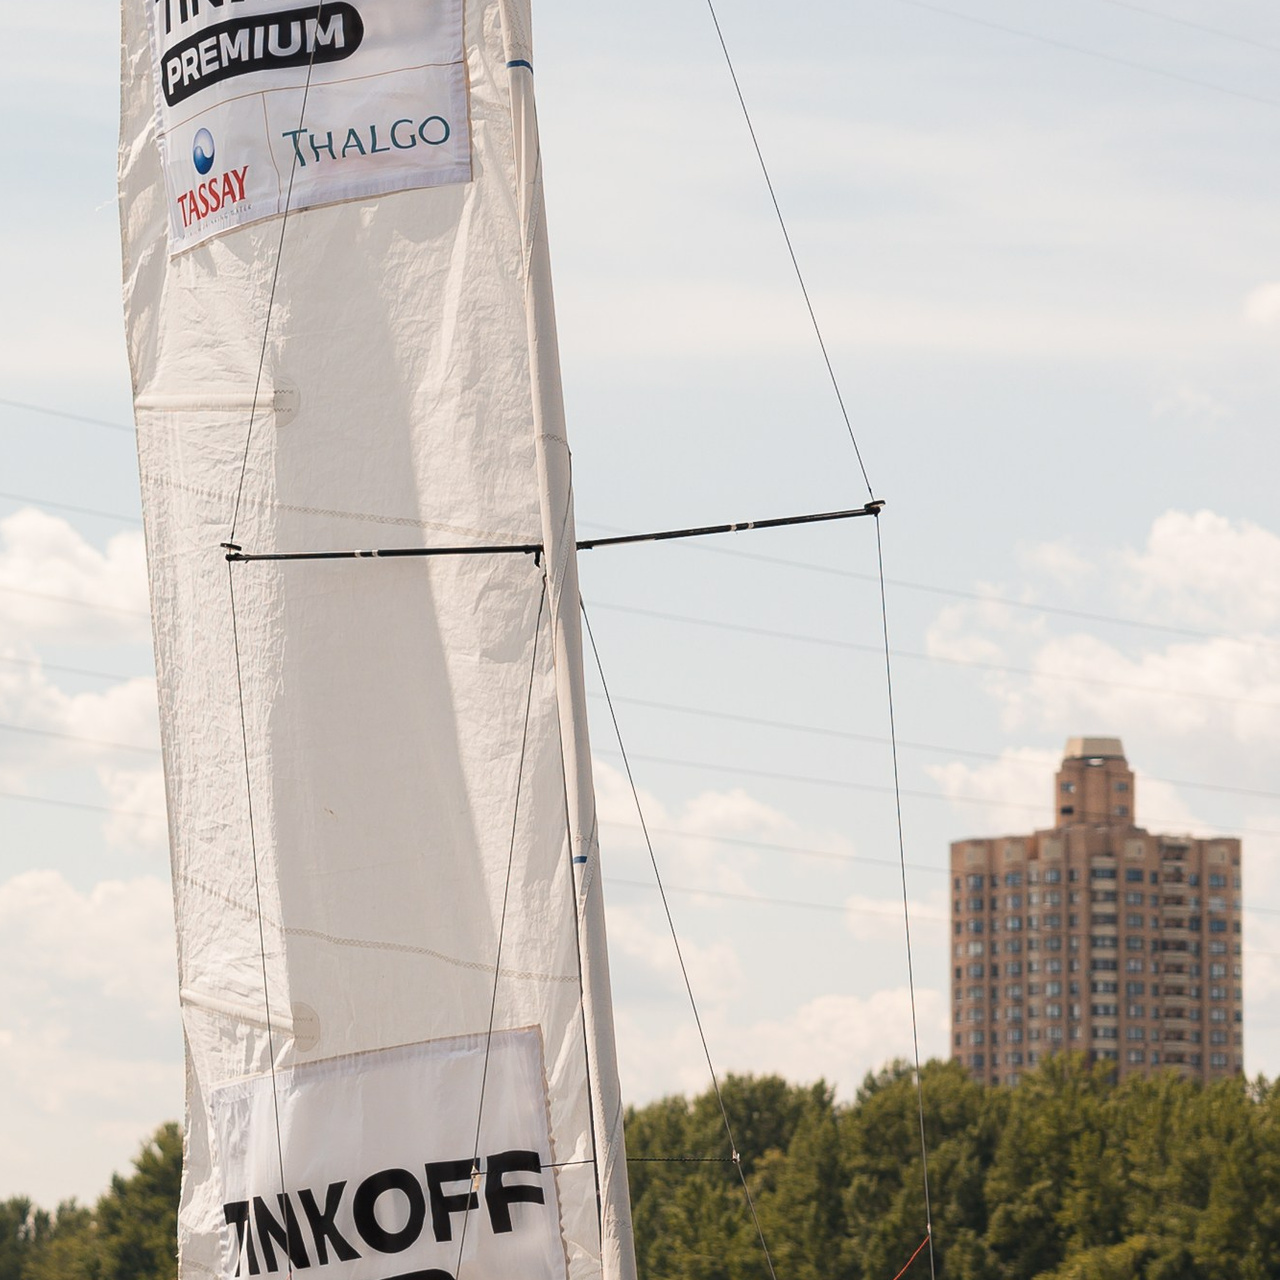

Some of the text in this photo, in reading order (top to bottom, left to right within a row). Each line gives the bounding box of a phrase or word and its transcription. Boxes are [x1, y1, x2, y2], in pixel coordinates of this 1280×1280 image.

[166, 13, 346, 96] PREMIUM
[282, 115, 451, 167] THALGO
[177, 164, 250, 228] TASSAY
[222, 1150, 546, 1278] TINKOFF
